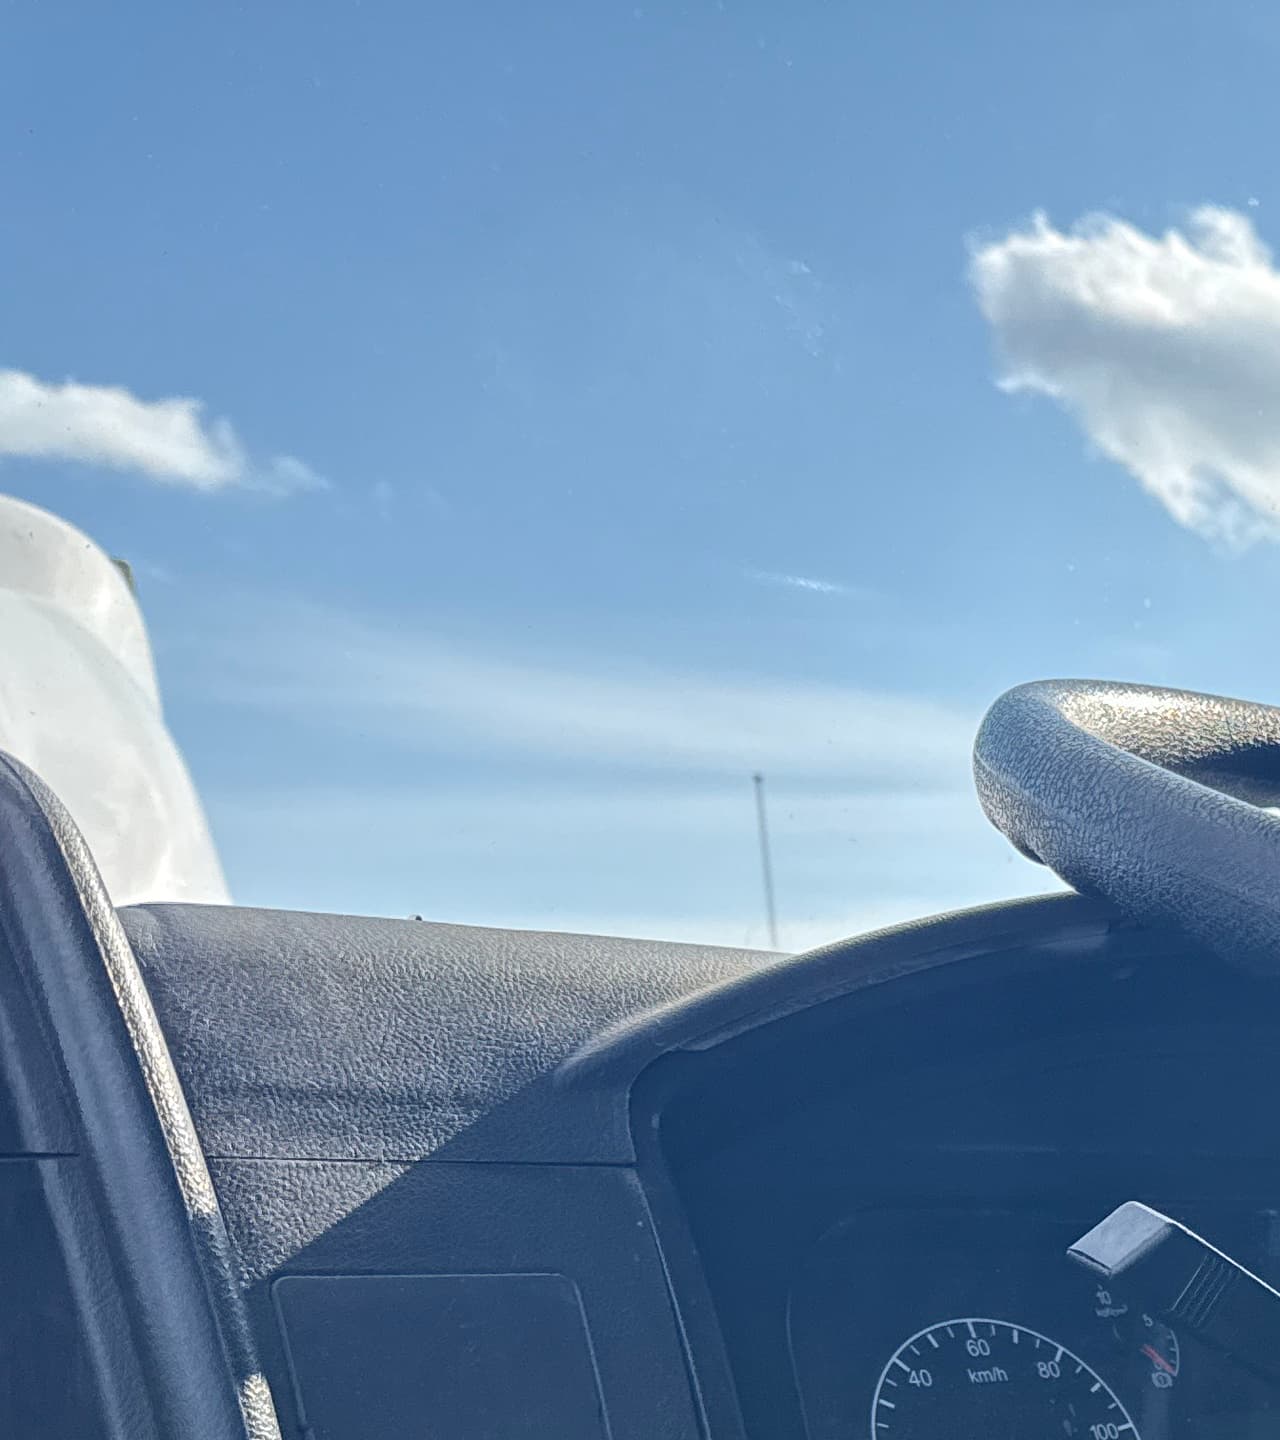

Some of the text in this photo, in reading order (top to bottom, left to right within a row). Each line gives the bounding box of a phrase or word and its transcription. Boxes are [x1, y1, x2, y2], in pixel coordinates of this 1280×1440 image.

[966, 1339, 991, 1358] 60
[908, 1368, 933, 1387] 40
[967, 1367, 1009, 1384] km/h
[1037, 1361, 1062, 1379] 80
[1089, 1423, 1119, 1440] 100
